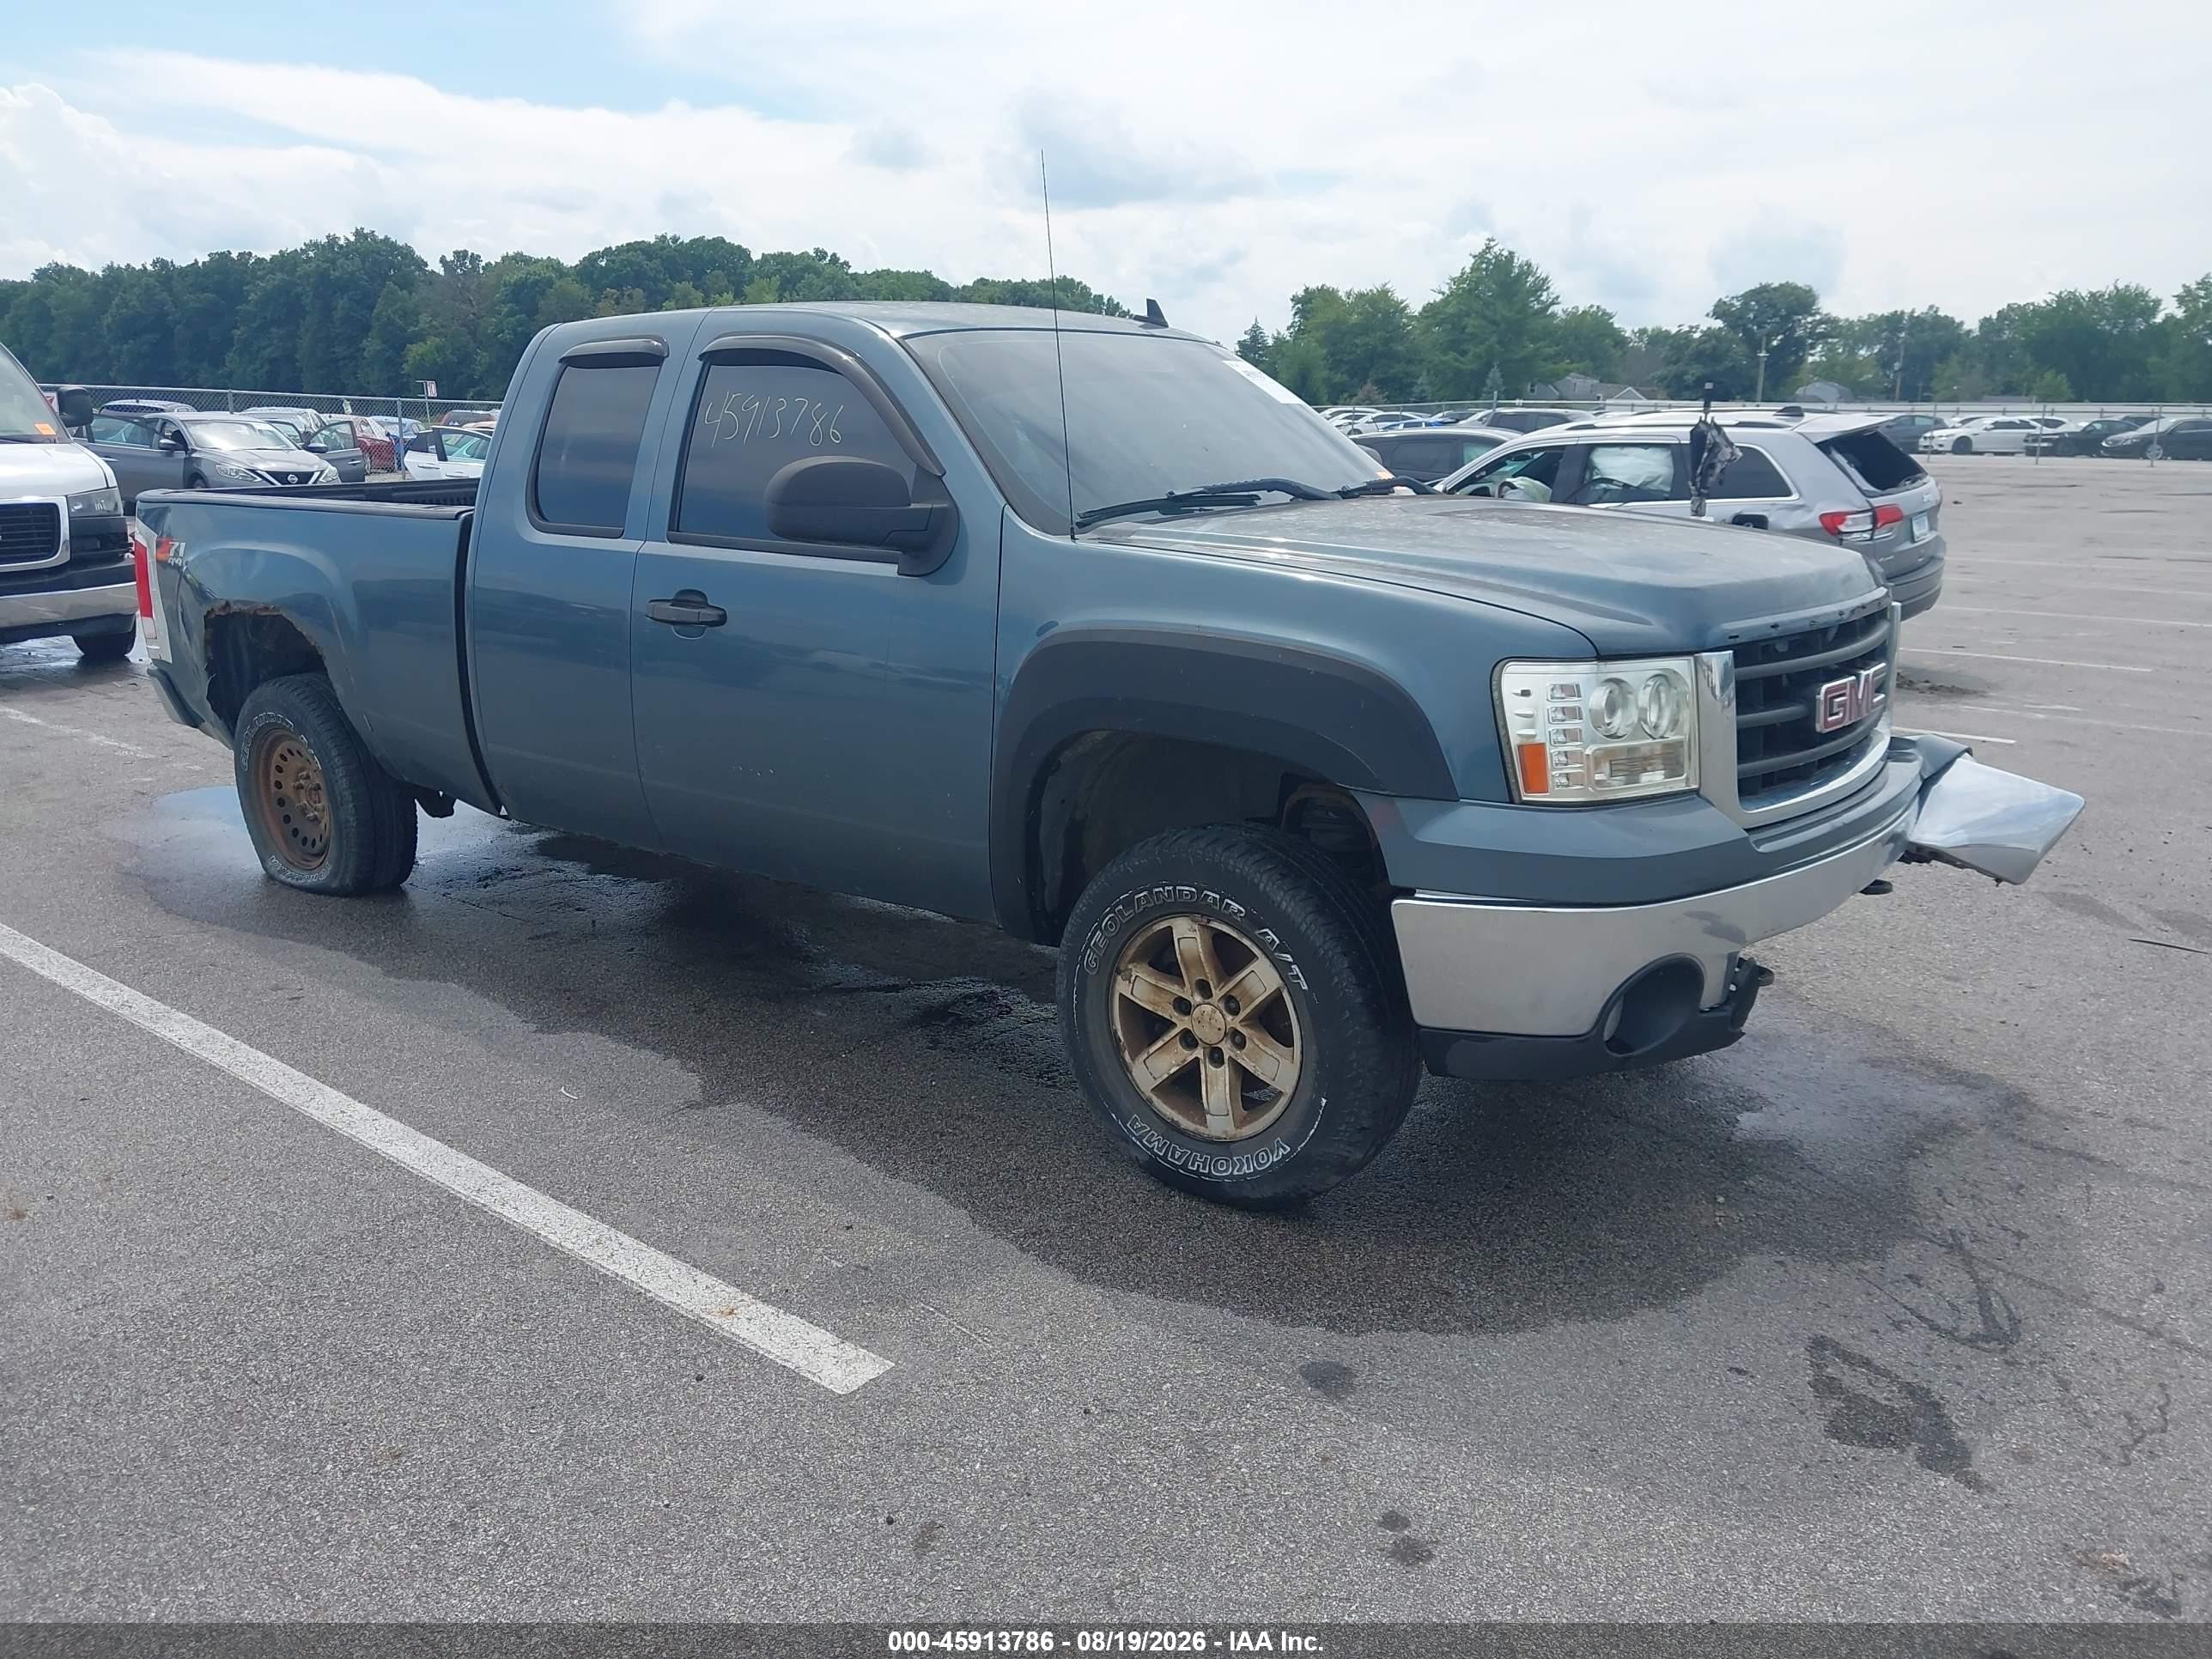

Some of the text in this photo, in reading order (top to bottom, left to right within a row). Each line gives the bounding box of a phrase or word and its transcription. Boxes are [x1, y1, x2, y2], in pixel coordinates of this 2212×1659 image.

[704, 391, 844, 447] 45913786
[1815, 662, 1887, 734] GMC
[1084, 885, 1246, 975] GEOLANDAR
[1126, 1114, 1291, 1176] YOKOHAMA
